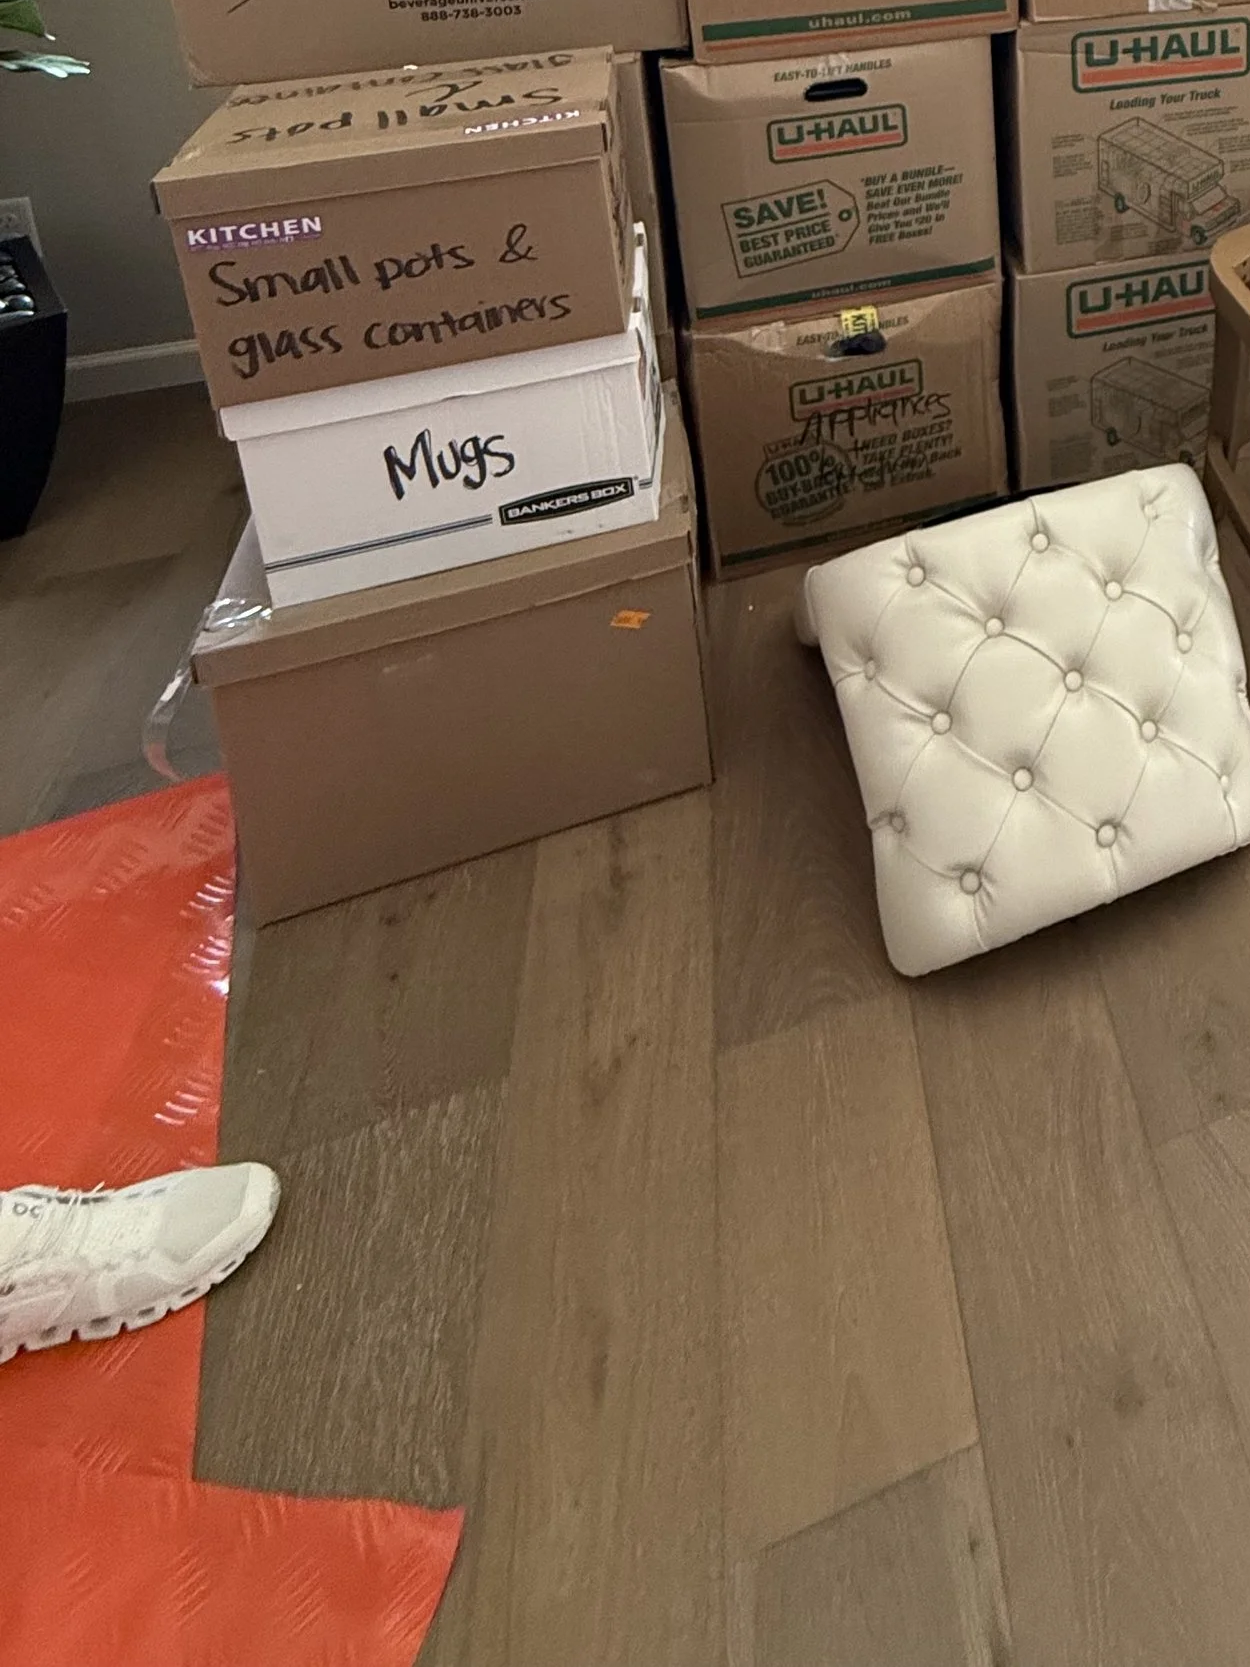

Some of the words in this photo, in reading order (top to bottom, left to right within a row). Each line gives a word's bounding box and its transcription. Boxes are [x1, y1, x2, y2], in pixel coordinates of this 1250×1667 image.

[421, 5, 522, 21] 888-738-3003
[808, 8, 912, 30] uhaul.com
[1084, 29, 1240, 67] U-HAUL
[846, 58, 892, 74] HANDLES
[1110, 95, 1156, 111] Loading
[1160, 92, 1185, 106] Your
[1189, 87, 1221, 101] Truck
[777, 113, 898, 145] U-HAUL
[865, 186, 894, 199] SAVE
[897, 181, 925, 194] EVEN
[890, 171, 898, 182] A
[733, 189, 827, 229] SAVE!
[187, 216, 322, 246] KITCHEN
[740, 232, 782, 253] BEST
[784, 219, 831, 242] PRICE
[869, 232, 895, 245] FREE
[209, 256, 359, 308] Small
[374, 241, 475, 291] pots
[499, 223, 538, 263] &
[1079, 270, 1204, 314] U-HAU
[227, 326, 342, 379] glass
[364, 291, 572, 350] containers
[1103, 335, 1148, 352] Loading
[1151, 330, 1176, 347] Your
[801, 367, 914, 406] U-HAUL
[383, 428, 516, 500] Mugs
[507, 492, 590, 520] BANKERS
[591, 482, 629, 502] BOX
